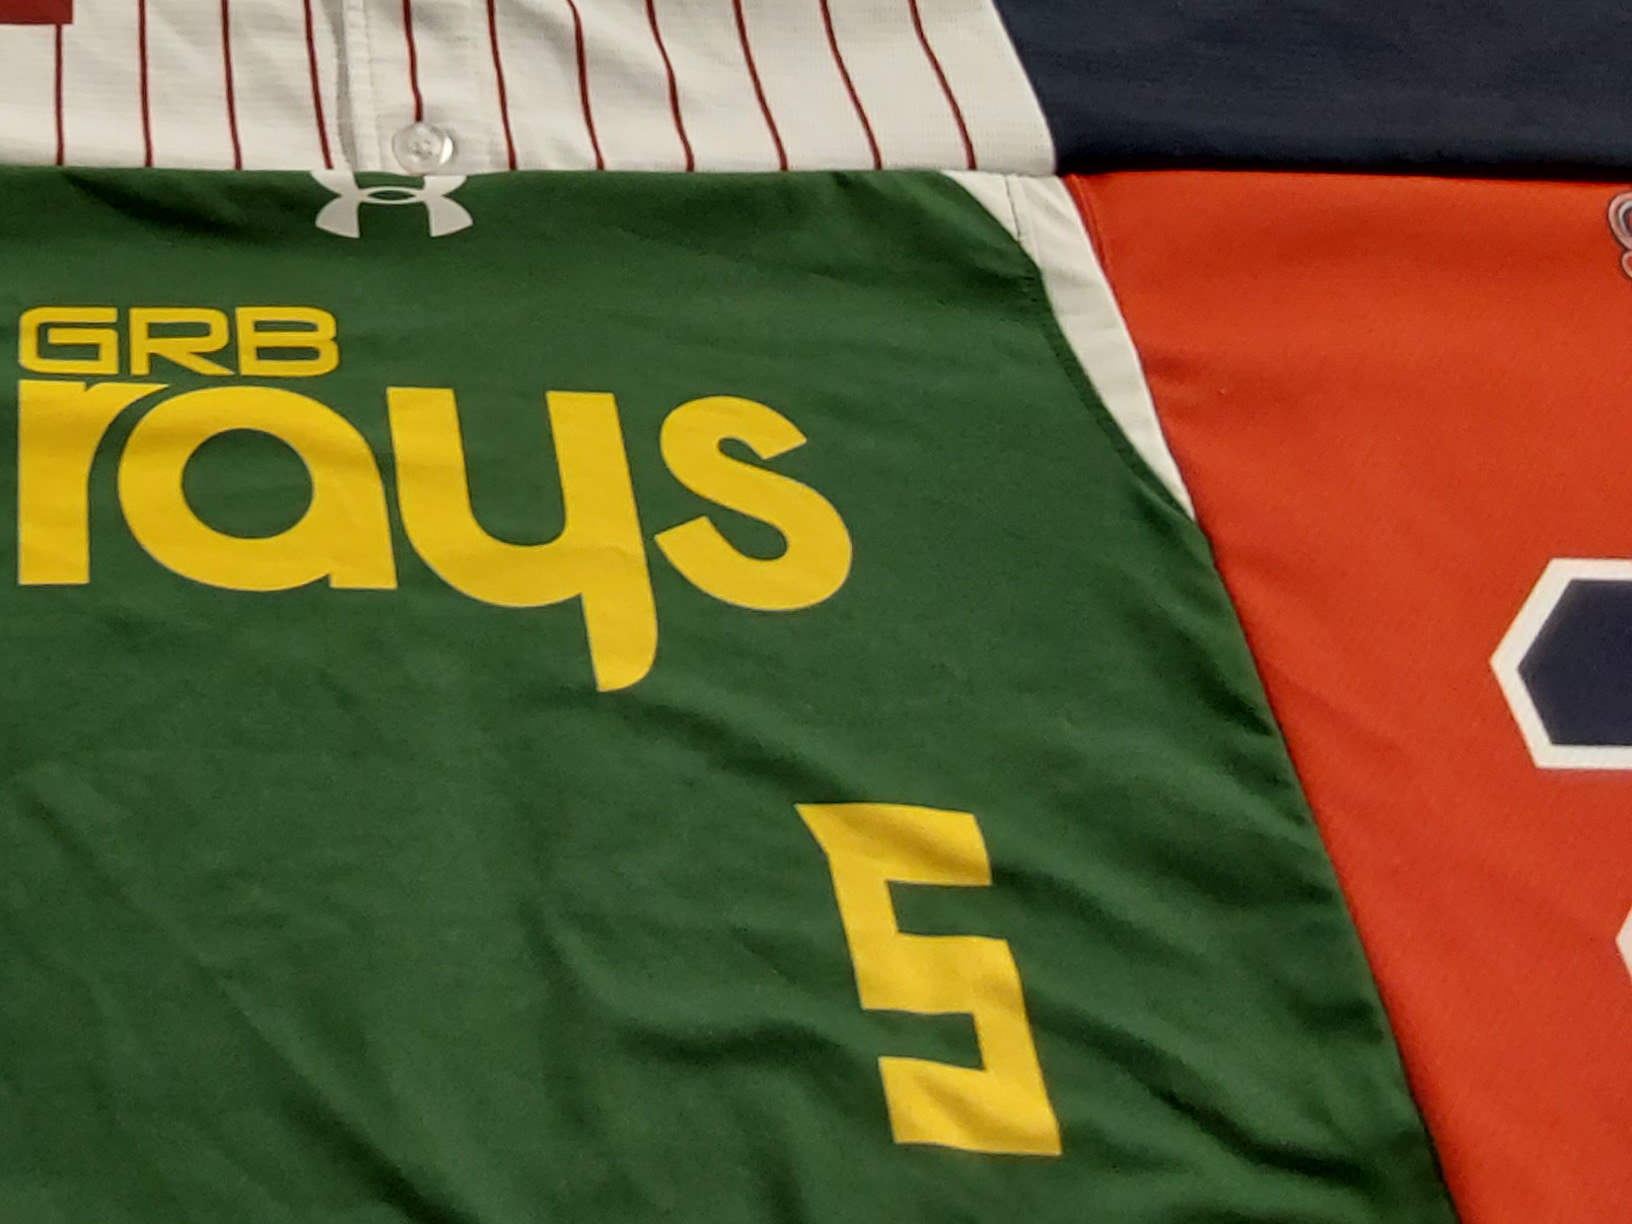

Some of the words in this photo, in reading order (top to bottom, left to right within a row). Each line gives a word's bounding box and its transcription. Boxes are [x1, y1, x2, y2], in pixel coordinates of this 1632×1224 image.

[17, 305, 341, 376] GRB
[17, 378, 853, 692] rays
[794, 802, 1063, 1157] 5
